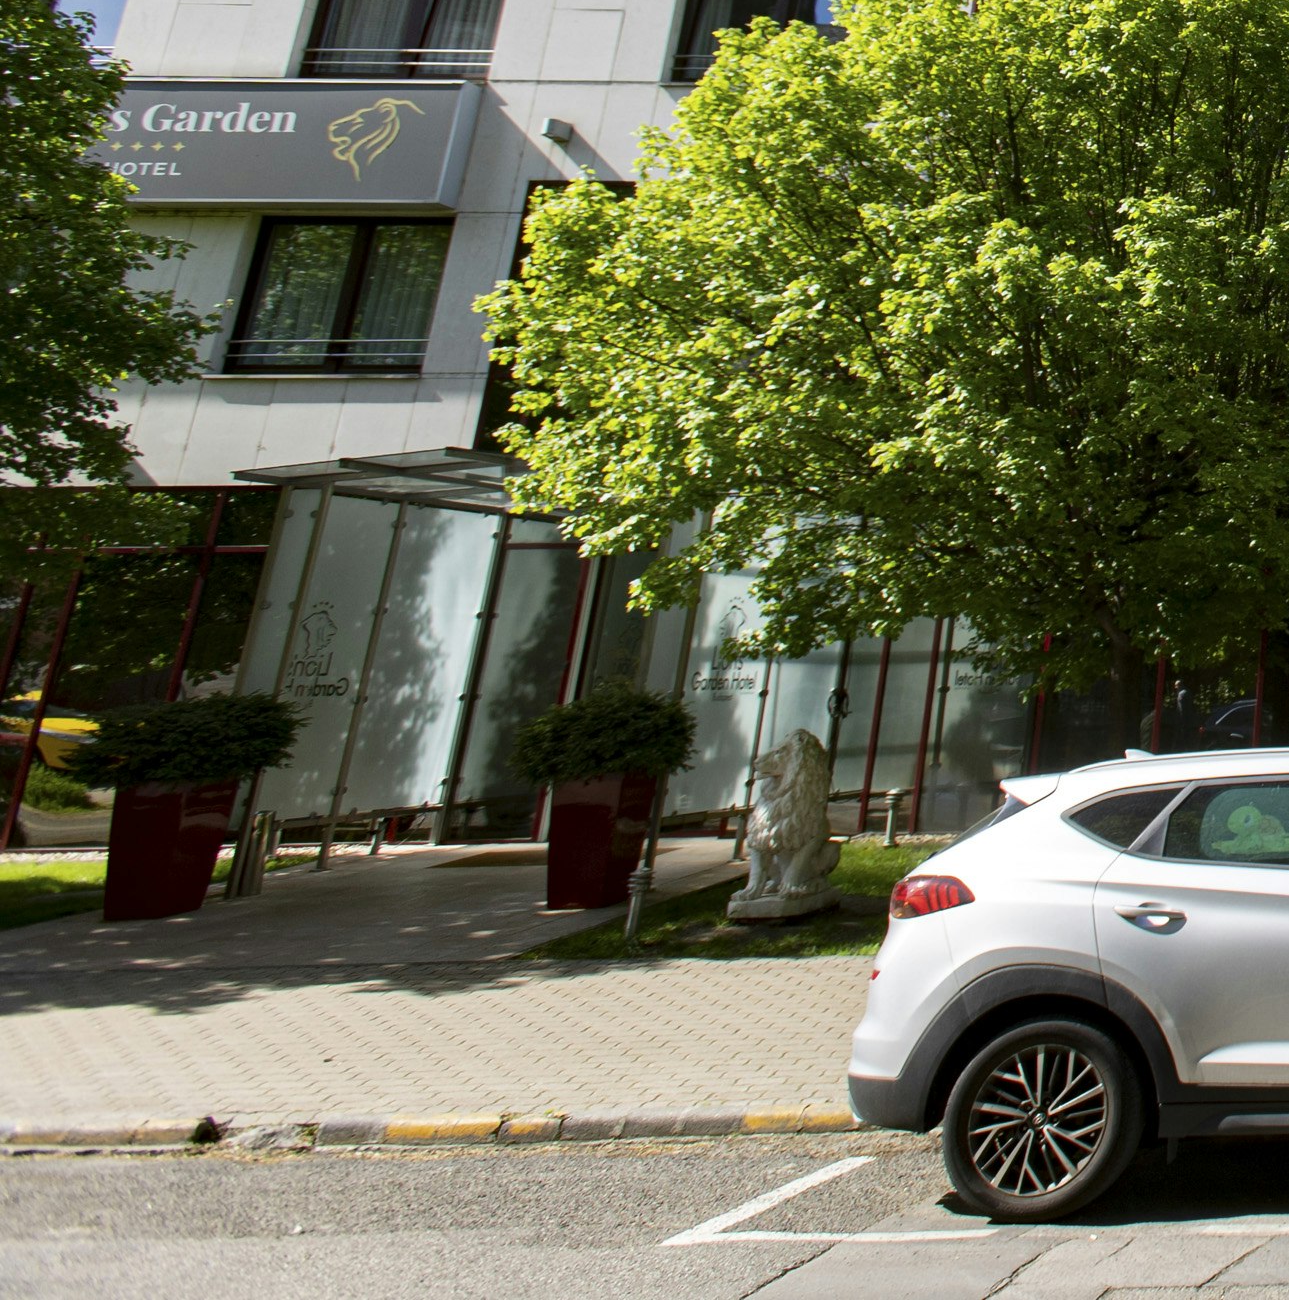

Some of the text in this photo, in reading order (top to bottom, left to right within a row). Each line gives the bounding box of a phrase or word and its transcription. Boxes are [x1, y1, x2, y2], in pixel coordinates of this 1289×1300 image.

[141, 102, 297, 133] Garden
[691, 670, 758, 691] Garden Hotel
